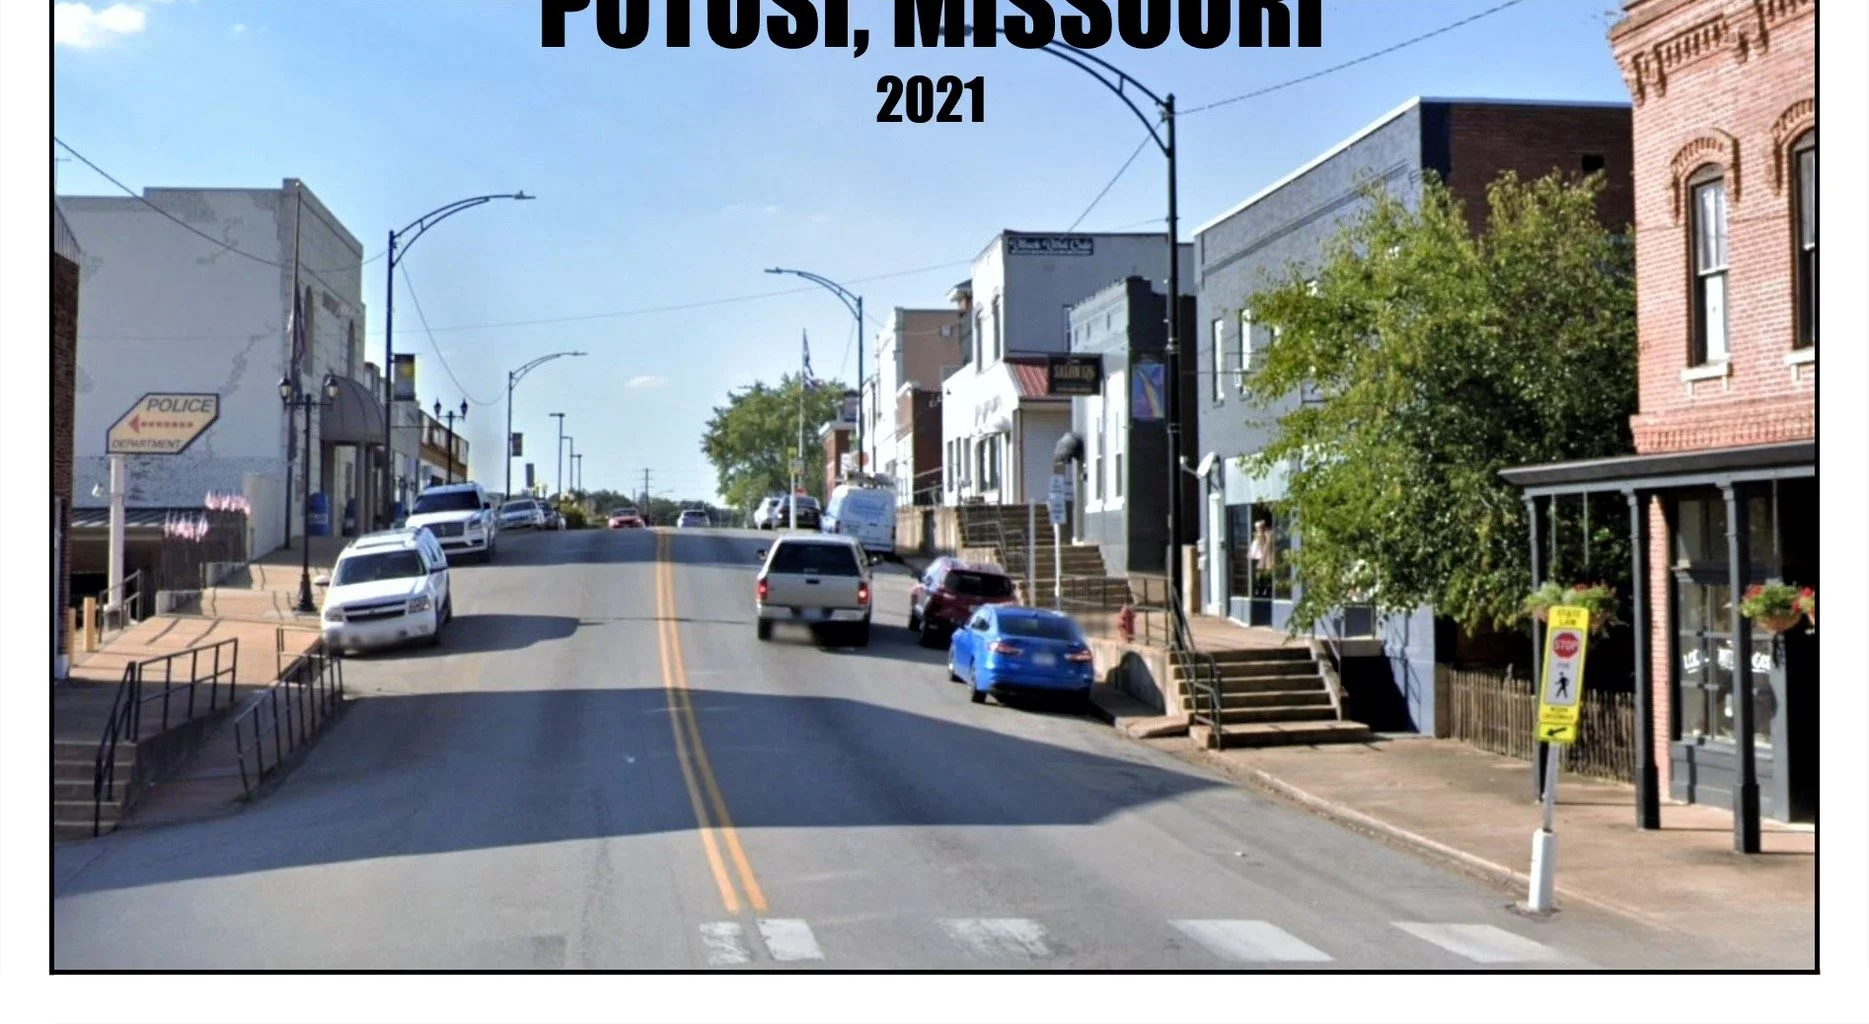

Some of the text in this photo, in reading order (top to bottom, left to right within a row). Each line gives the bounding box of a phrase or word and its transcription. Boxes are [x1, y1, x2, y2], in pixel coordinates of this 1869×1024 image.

[145, 397, 213, 414] POLICE
[112, 439, 182, 449] DEPARTMENT
[1554, 639, 1578, 651] STOP
